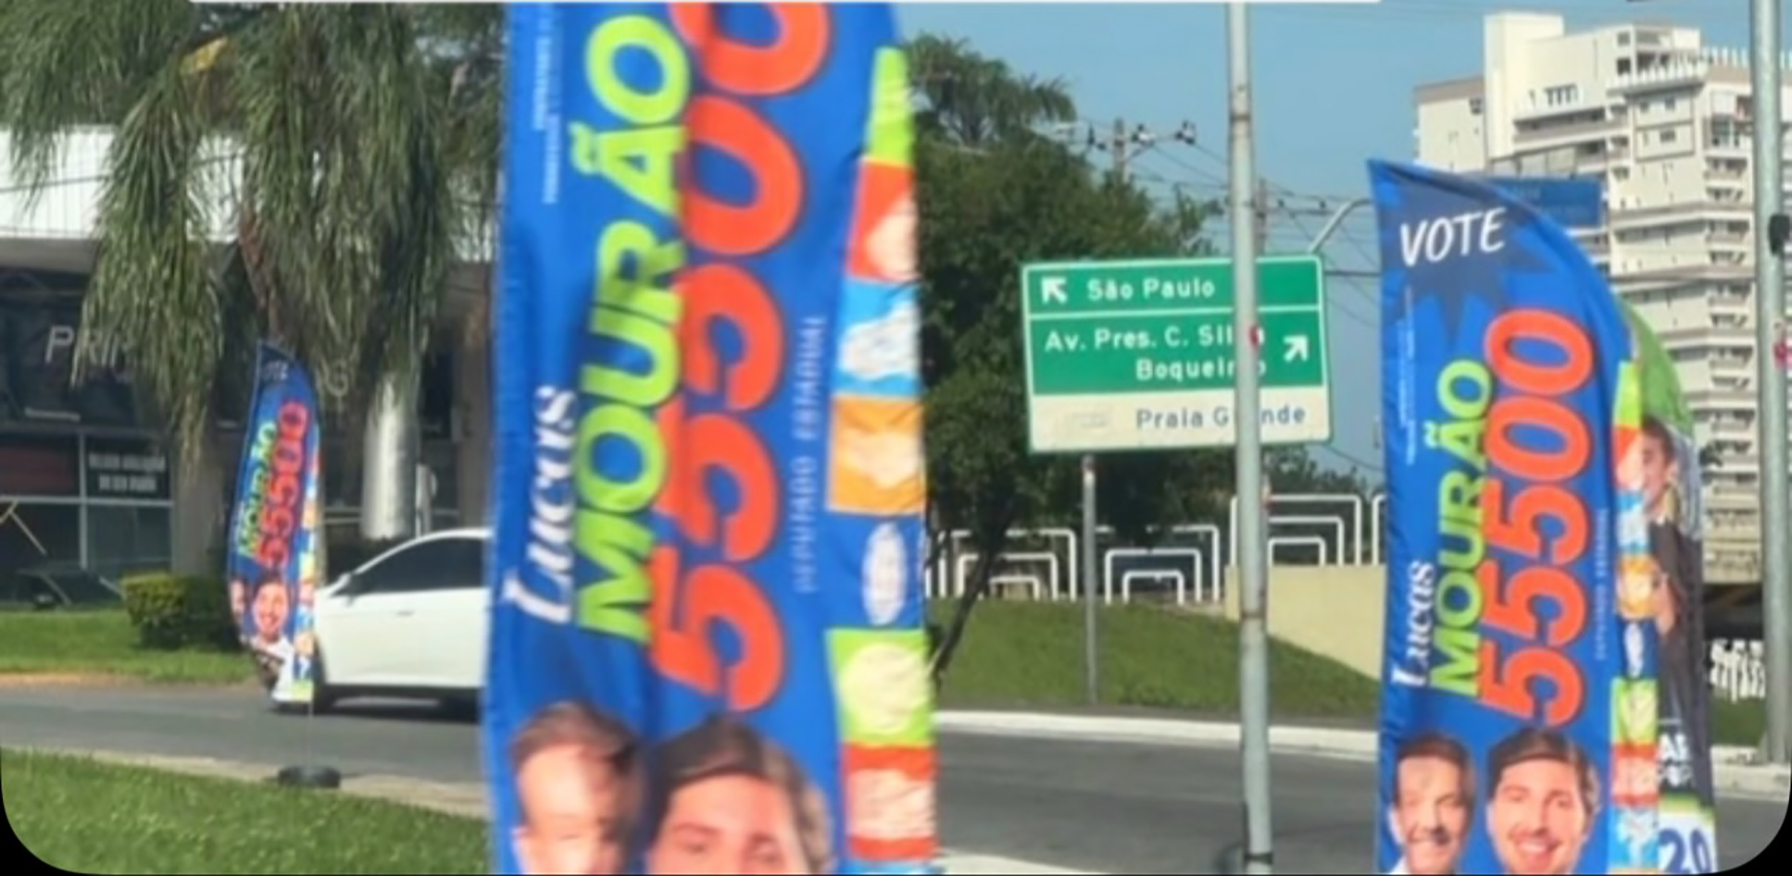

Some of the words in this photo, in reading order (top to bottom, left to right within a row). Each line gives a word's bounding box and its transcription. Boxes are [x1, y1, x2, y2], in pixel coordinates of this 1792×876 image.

[1086, 277, 1134, 301] São
[1143, 276, 1216, 299] Paulo
[1400, 206, 1507, 267] VOTE
[568, 13, 690, 644] MOURÃO
[1044, 330, 1085, 352] Av.
[1094, 326, 1156, 350] Pres.
[1164, 325, 1188, 347] C.
[1198, 324, 1265, 347] Sil
[1136, 408, 1204, 430] Praia
[1212, 404, 1307, 427] Gnde
[502, 385, 576, 623] Lucas
[1424, 360, 1493, 697] MOURÃO
[1475, 308, 1595, 729] 55500
[1391, 559, 1435, 688] Lucas
